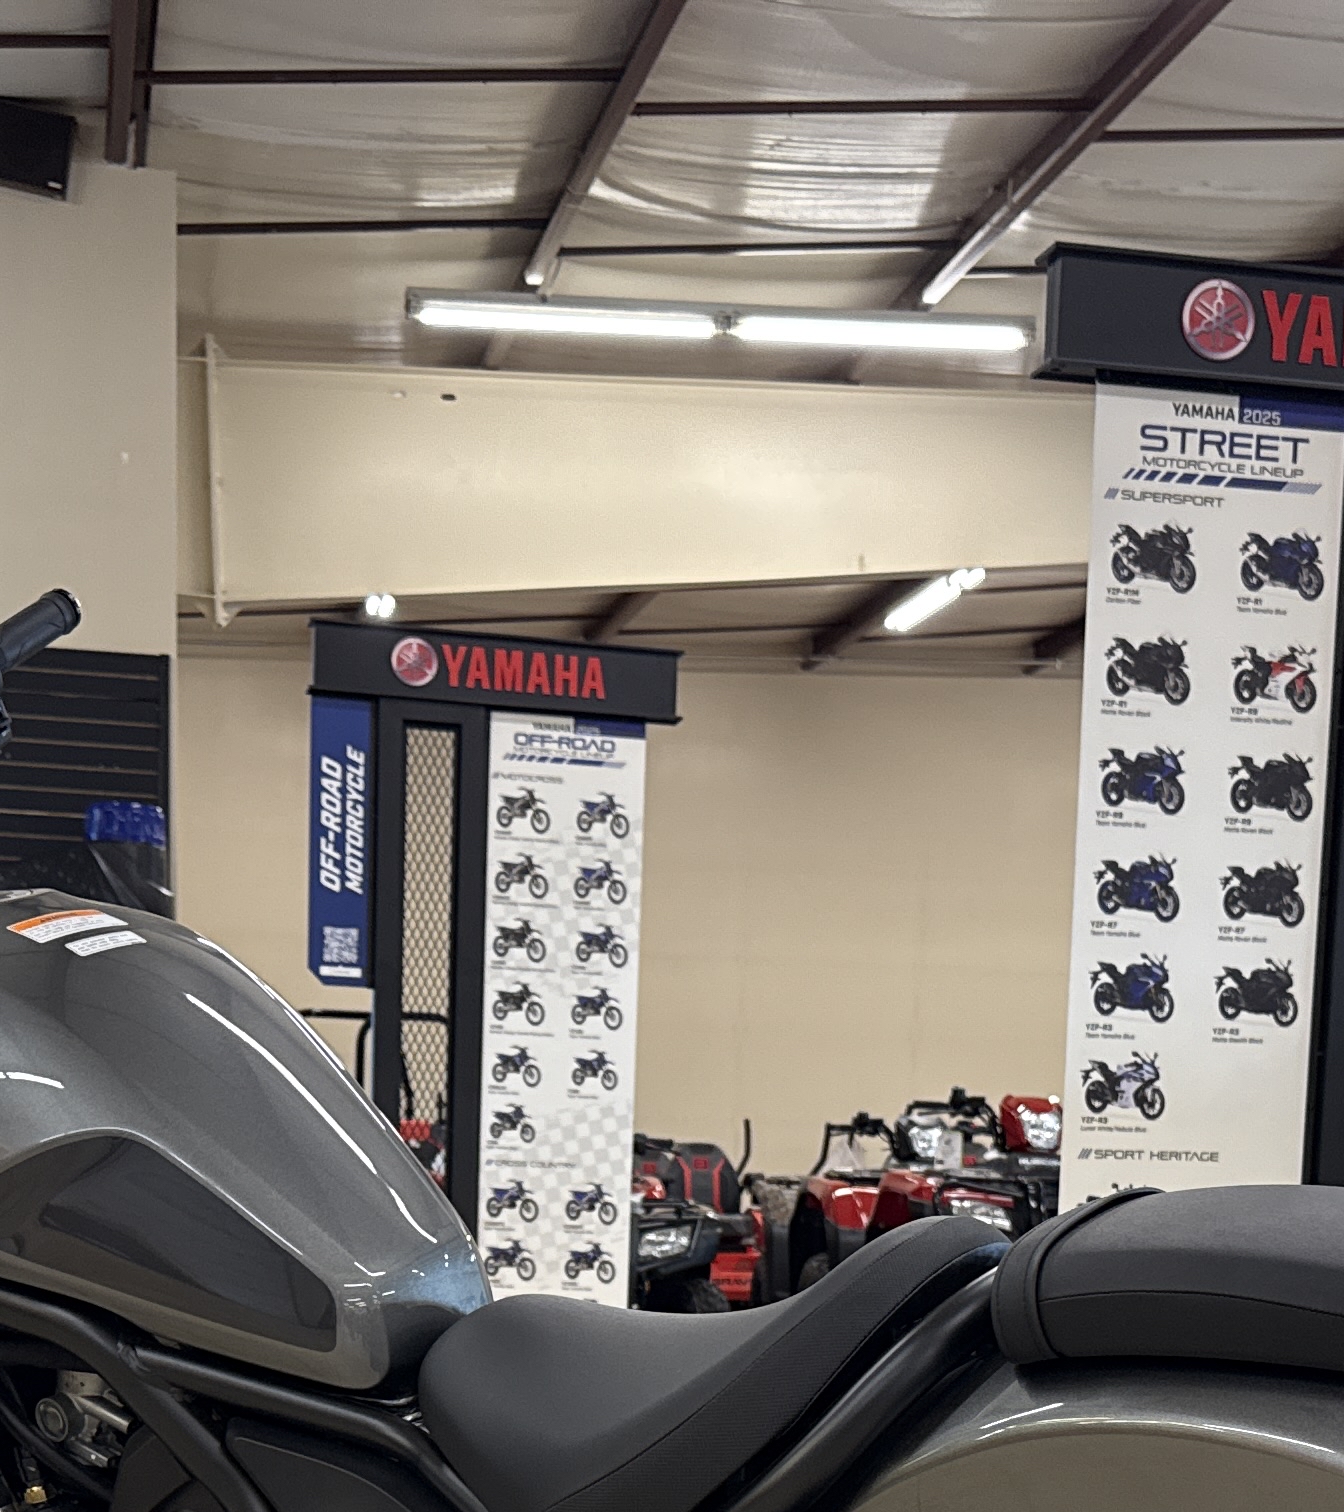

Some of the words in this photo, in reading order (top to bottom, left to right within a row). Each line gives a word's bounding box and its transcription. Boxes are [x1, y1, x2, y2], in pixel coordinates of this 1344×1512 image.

[1172, 402, 1236, 421] YAMAHA
[1243, 409, 1281, 426] 2025
[1139, 424, 1310, 465] STREET
[1141, 455, 1246, 475] MOTORCYCLE
[1250, 464, 1304, 479] LINEUP
[1120, 489, 1226, 508] SUPERSPORT
[441, 643, 607, 701] YAMAHA
[513, 732, 616, 753] OFF-ROAD
[319, 756, 343, 894] OFF-ROAD
[343, 744, 367, 896] MOTORCYCLE
[1094, 1149, 1145, 1161] SPORT
[1149, 1150, 1220, 1162] HERITAGE
